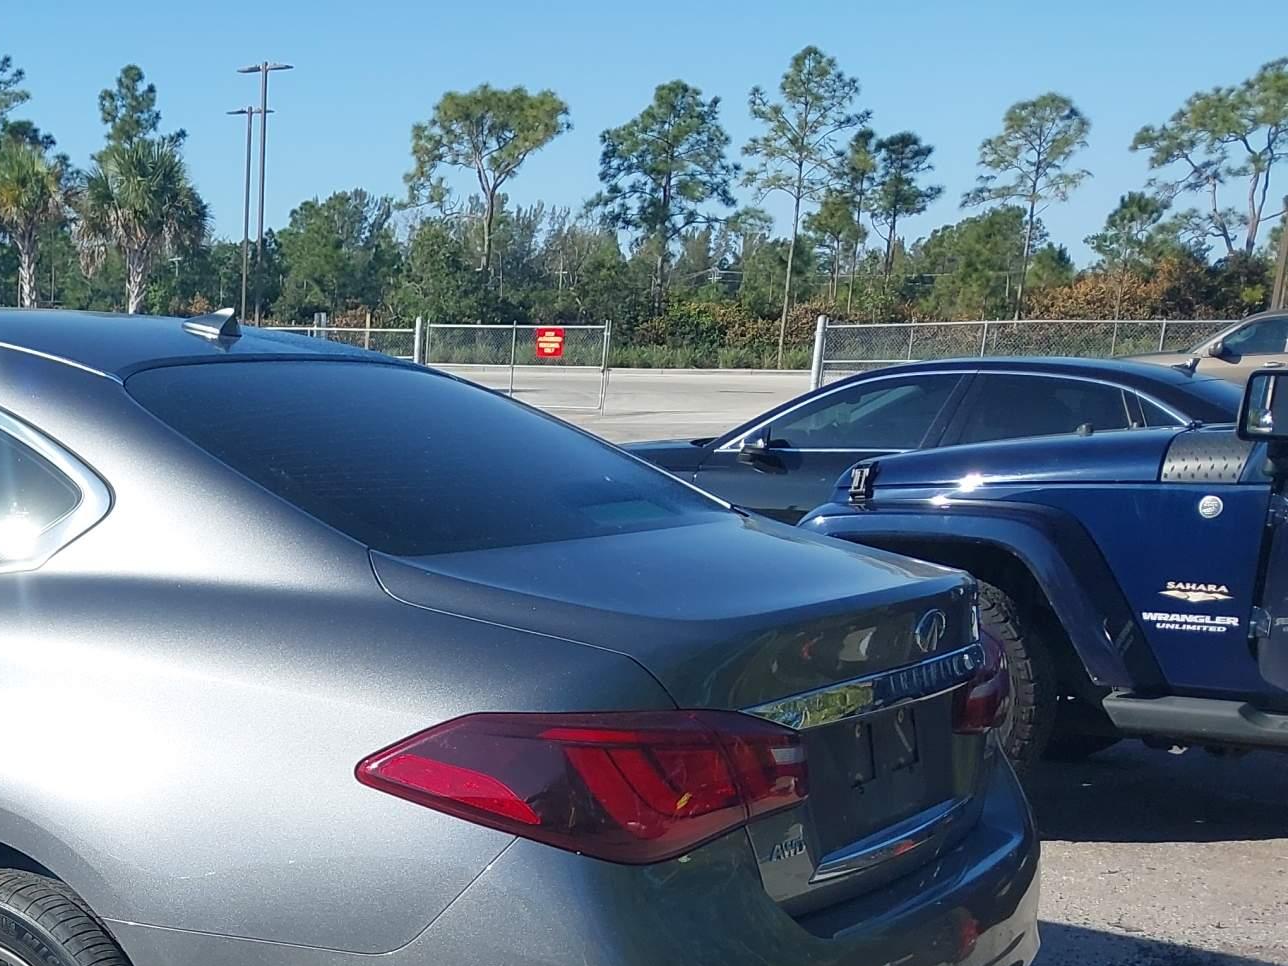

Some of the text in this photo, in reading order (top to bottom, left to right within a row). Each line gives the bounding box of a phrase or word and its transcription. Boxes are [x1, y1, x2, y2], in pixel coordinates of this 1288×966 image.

[1166, 581, 1229, 592] SAHARA
[1142, 611, 1240, 627] WRANGLER
[1155, 622, 1227, 633] UNLIMITED
[770, 840, 807, 862] AWD
